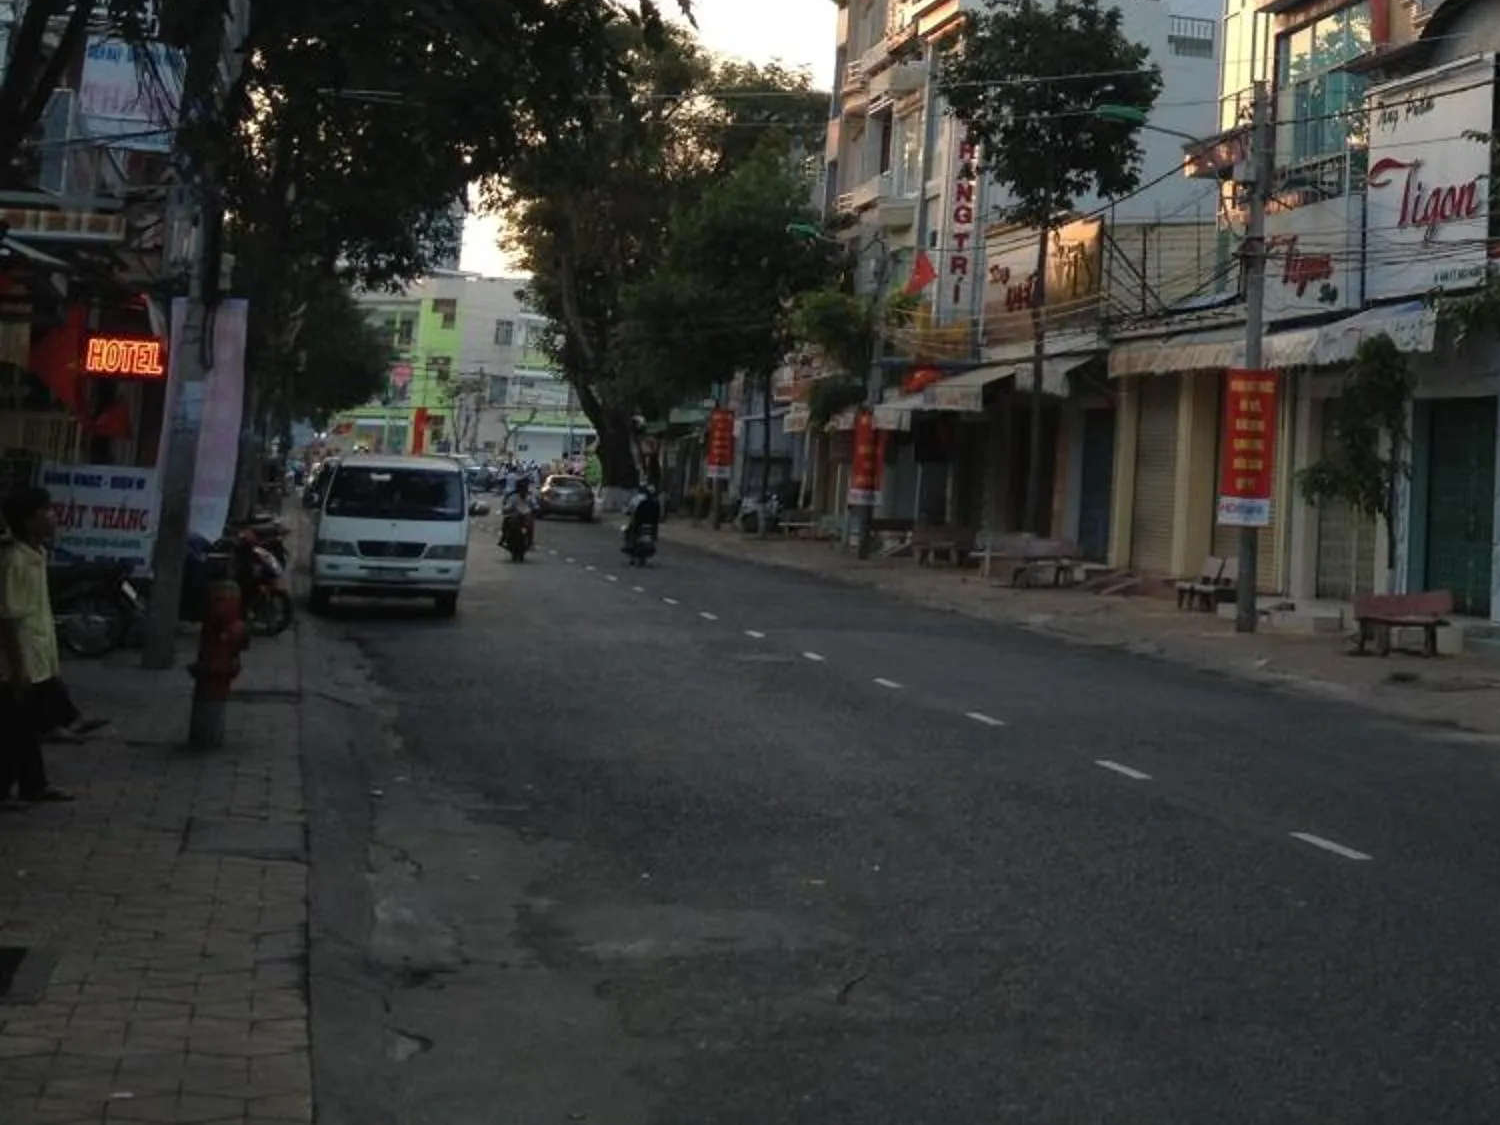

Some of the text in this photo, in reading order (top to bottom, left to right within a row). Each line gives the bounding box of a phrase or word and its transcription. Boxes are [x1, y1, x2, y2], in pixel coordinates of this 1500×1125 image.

[954, 127, 977, 225] RANG
[1367, 157, 1480, 246] Tigon
[85, 335, 165, 378] HOTEL
